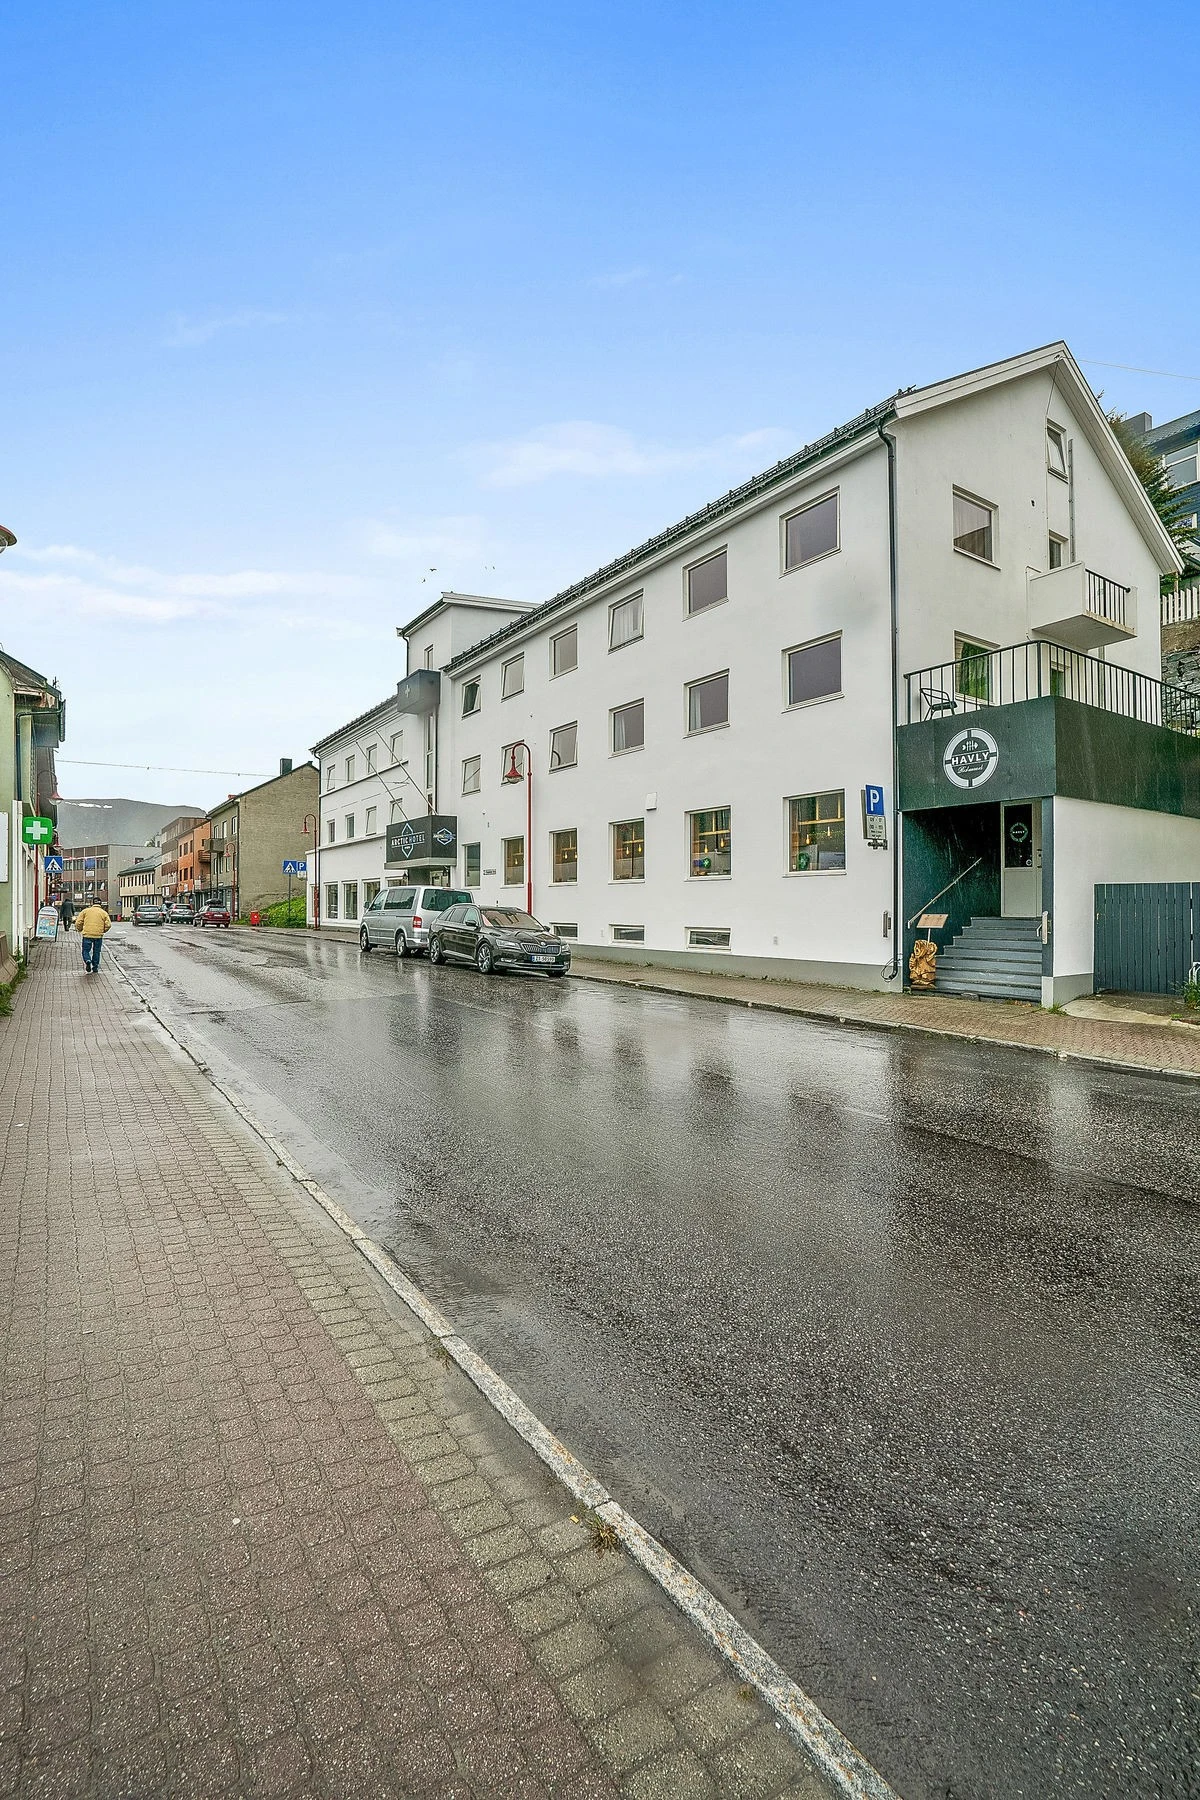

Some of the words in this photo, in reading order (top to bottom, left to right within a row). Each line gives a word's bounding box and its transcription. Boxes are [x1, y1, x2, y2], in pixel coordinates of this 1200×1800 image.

[951, 752, 989, 765] HAVLY
[870, 789, 880, 811] P
[391, 837, 409, 846] ARCTIC
[409, 834, 425, 844] HOTEL
